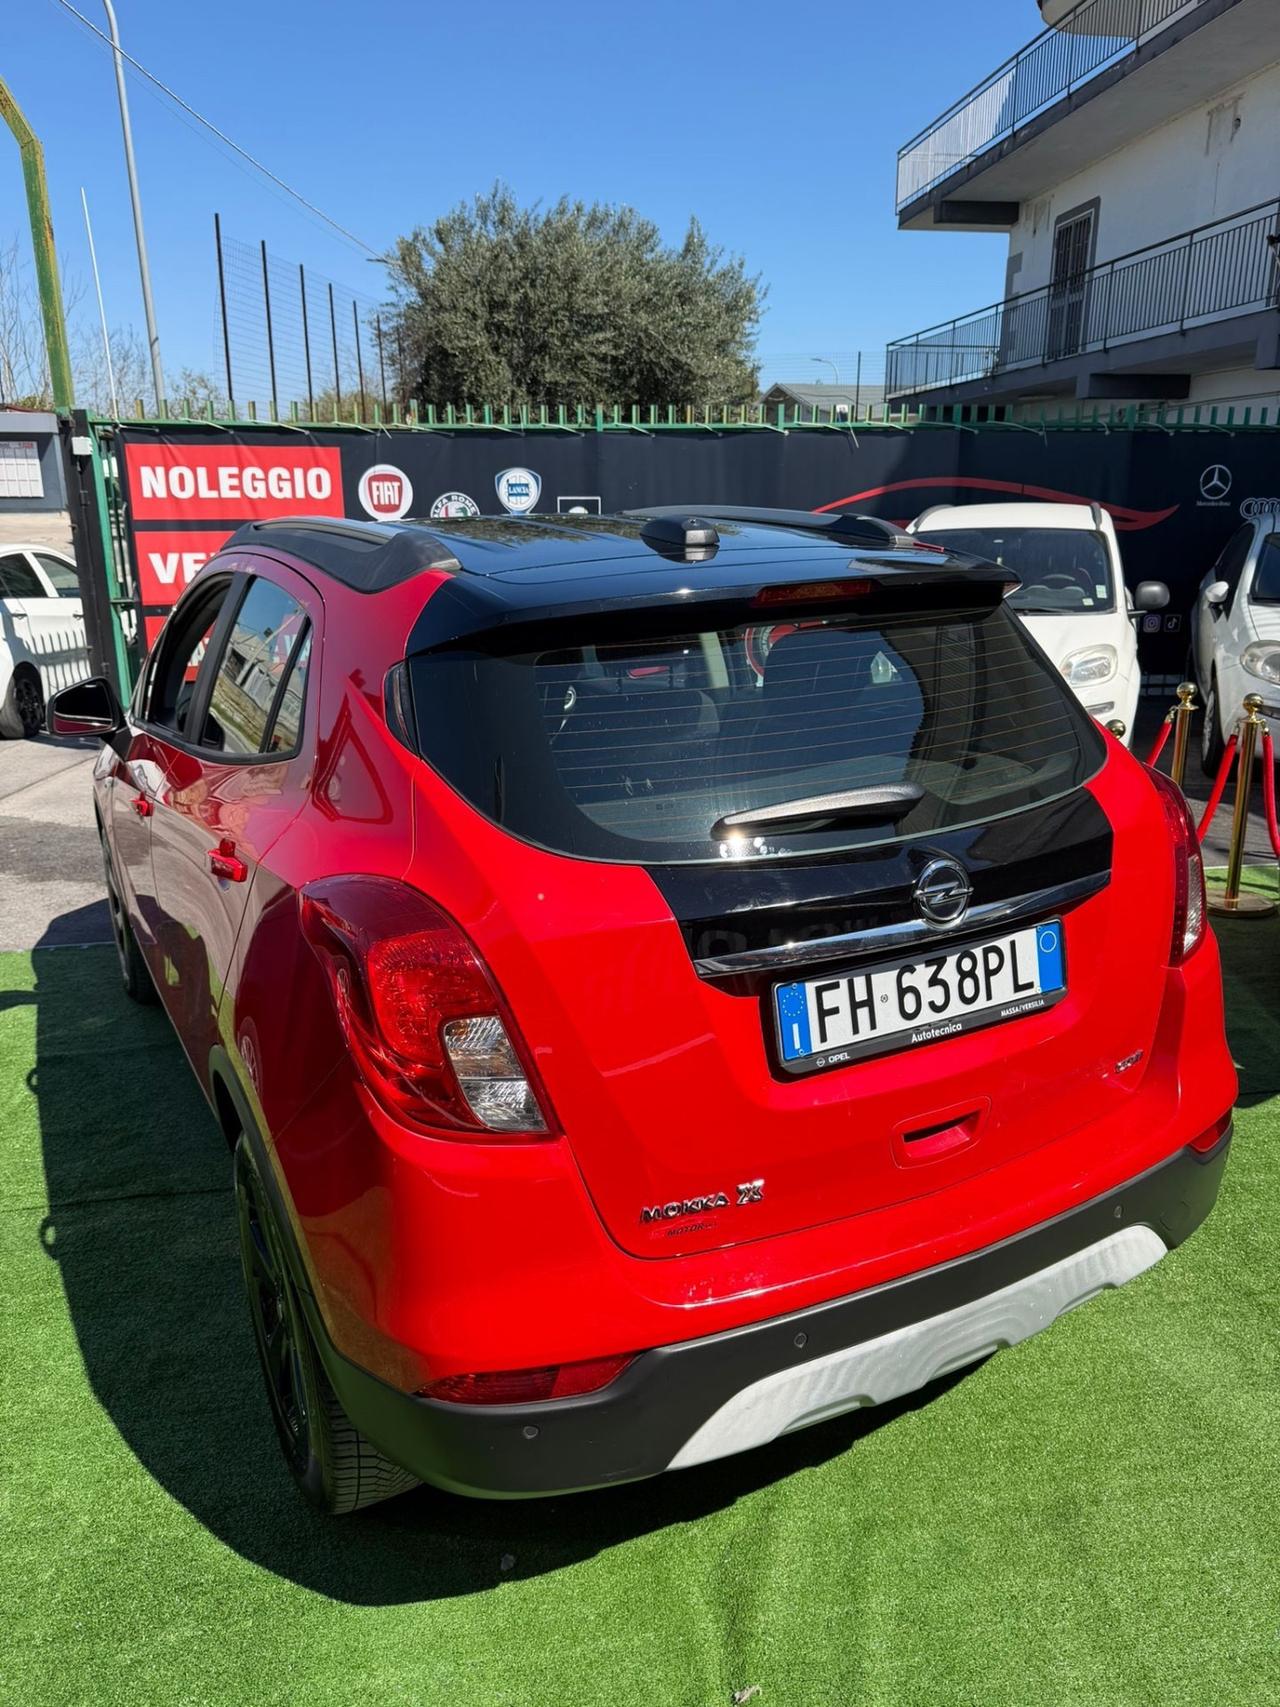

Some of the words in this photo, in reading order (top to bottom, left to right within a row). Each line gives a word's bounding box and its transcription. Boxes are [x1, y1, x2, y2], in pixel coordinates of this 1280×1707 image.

[140, 466, 332, 499] NOLEGGIO
[371, 481, 400, 506] FIAT
[451, 495, 477, 515] ROME
[814, 973, 877, 1044] FH
[896, 939, 1035, 1021] 638PL
[911, 1023, 963, 1043] Autotecnica
[828, 1053, 850, 1064] OPEL
[640, 1192, 730, 1223] MOKKA
[736, 1178, 765, 1205] X
